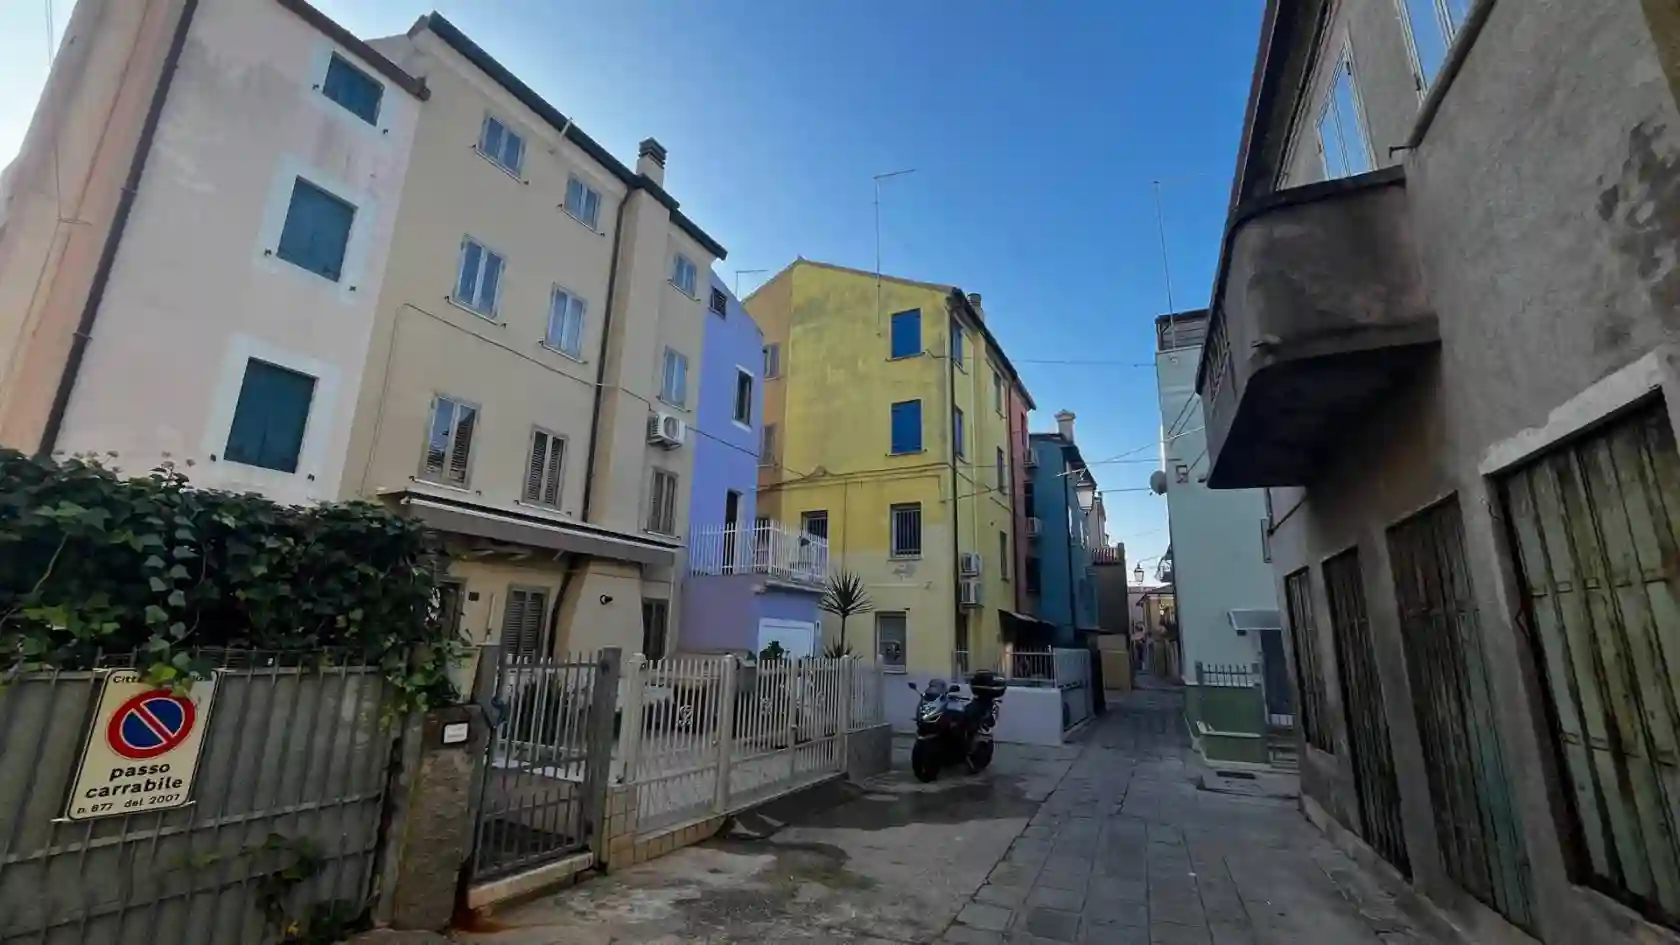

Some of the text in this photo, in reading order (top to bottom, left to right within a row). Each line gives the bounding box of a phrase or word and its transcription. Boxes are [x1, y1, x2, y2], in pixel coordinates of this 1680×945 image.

[109, 763, 170, 781] passo
[85, 776, 183, 799] carrabile
[91, 802, 114, 813] 877
[124, 799, 144, 808] del
[148, 793, 180, 805] 2007
